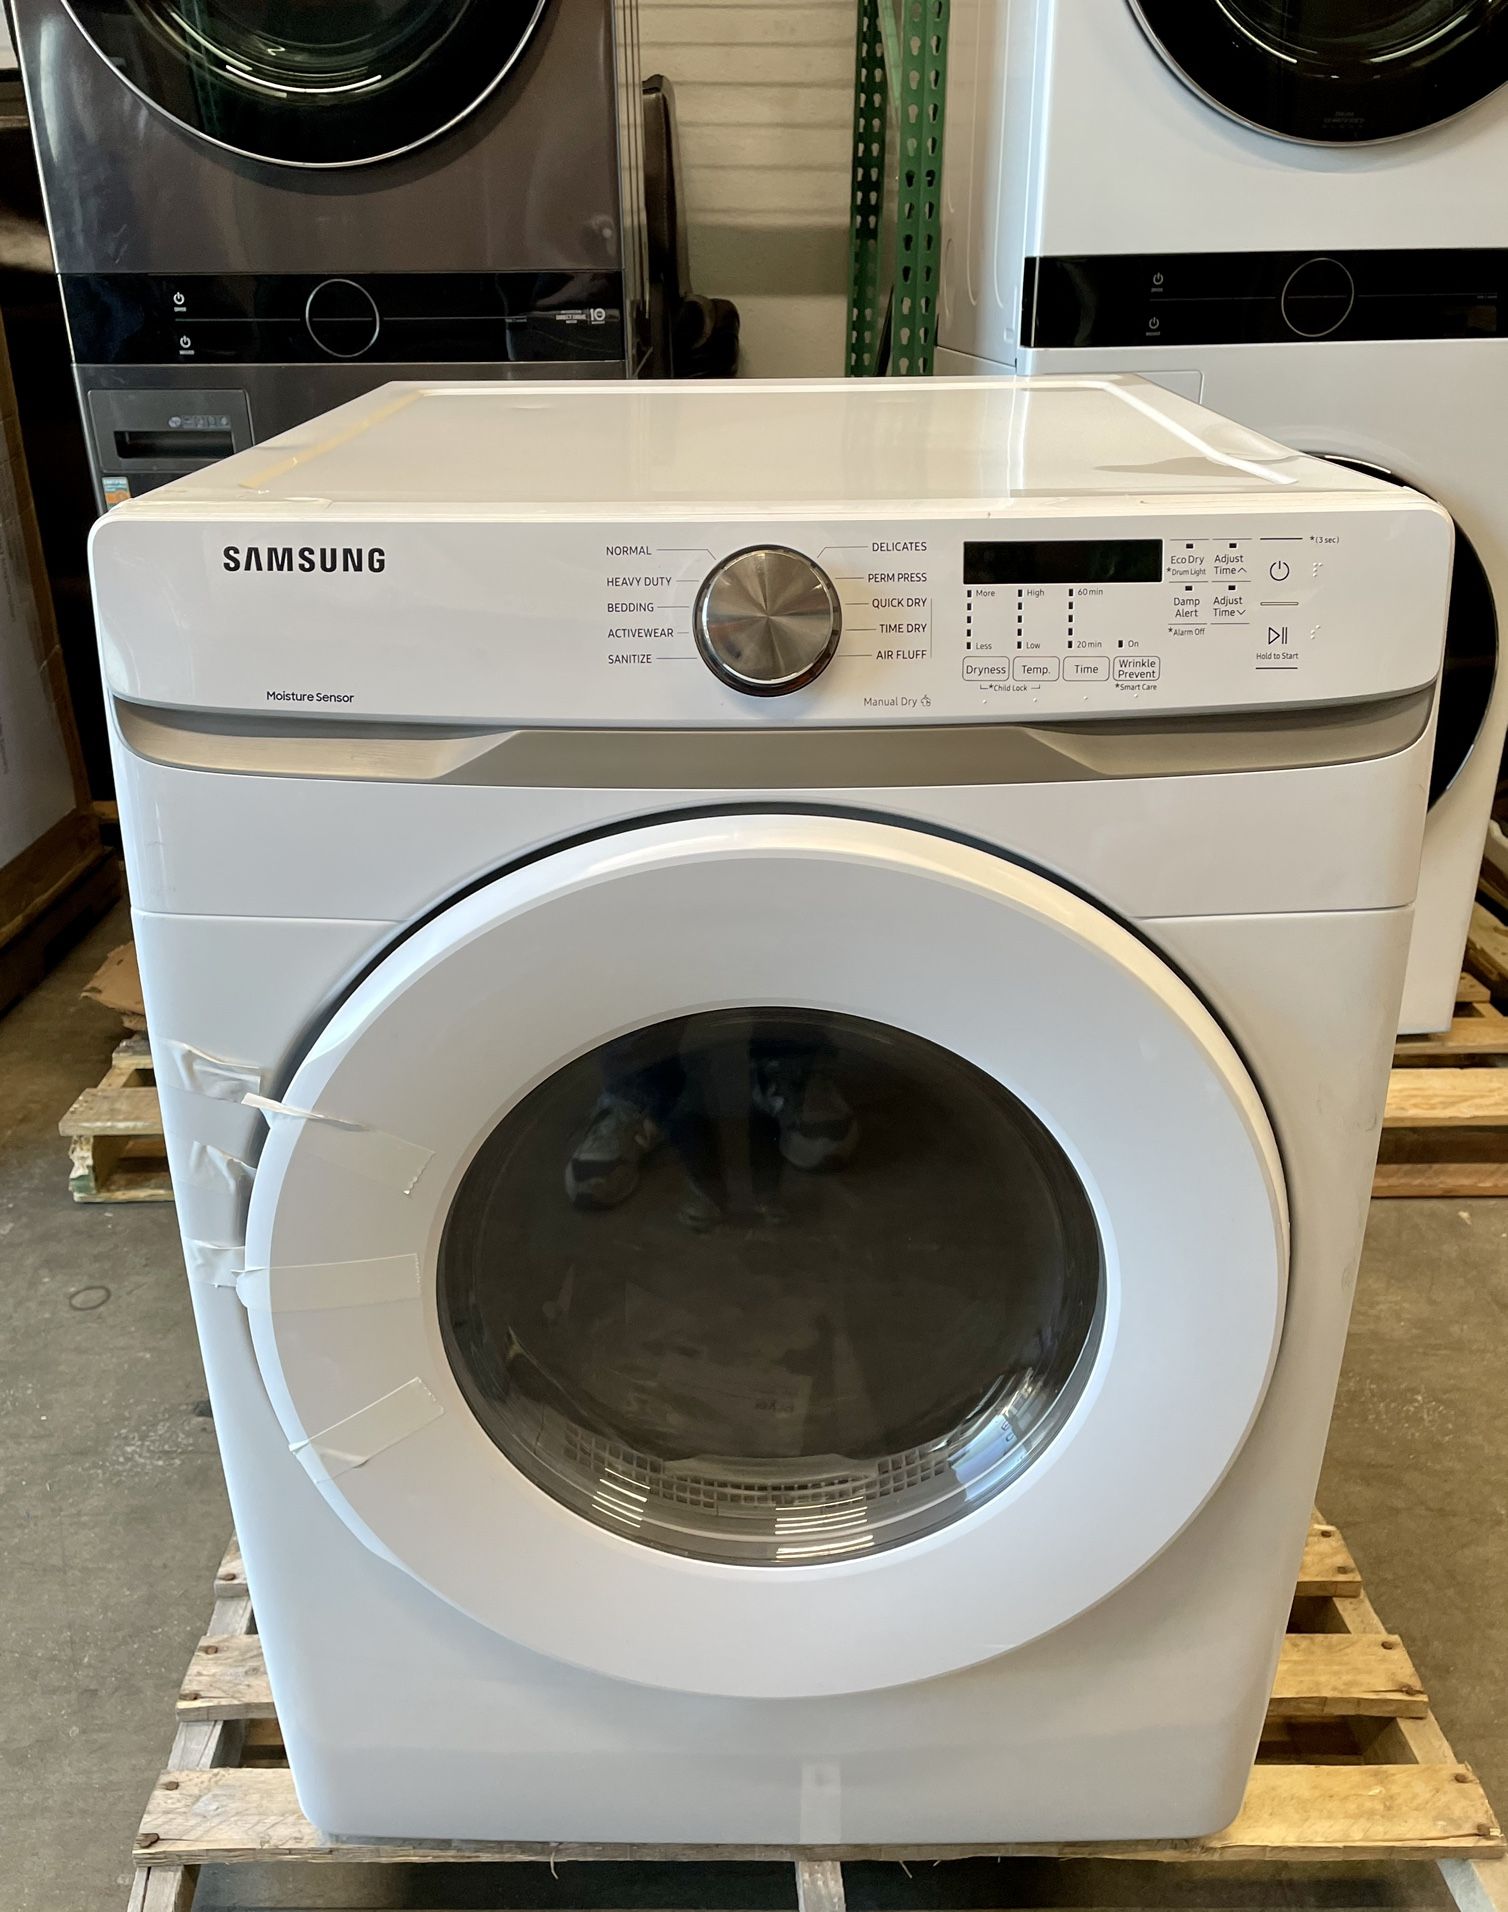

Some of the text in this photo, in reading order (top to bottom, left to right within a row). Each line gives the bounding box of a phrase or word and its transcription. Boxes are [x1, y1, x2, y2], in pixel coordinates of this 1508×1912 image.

[606, 546, 652, 556] NORMAL
[872, 542, 927, 552] DELICATES
[223, 546, 386, 573] SAMSUNG
[1171, 556, 1204, 565] Eco Dry
[1215, 555, 1243, 563] Adjust
[1214, 566, 1236, 574] Time
[607, 577, 671, 587] HEAVY DUTY
[868, 573, 927, 583] PERM PRESS
[976, 589, 995, 597] More
[1027, 588, 1044, 598] High
[872, 598, 927, 609] QUICK DRY
[1173, 598, 1200, 607] Damp
[1214, 597, 1242, 605] Adjust
[607, 603, 654, 612] BEDDING
[1213, 608, 1235, 616] Time
[1175, 609, 1198, 618] Alert
[608, 628, 674, 638] ACTIVEWEAR
[880, 624, 927, 633] TIME DRY
[976, 642, 992, 650] Less
[1027, 641, 1040, 649] Low
[1128, 640, 1139, 648] On
[608, 654, 652, 664] SANITIZE
[876, 650, 927, 660] AIR FLUFF
[1119, 660, 1156, 668] Wrinkle
[966, 665, 1006, 676] Dryness
[1022, 665, 1050, 675] Temp.
[1074, 665, 1099, 673] Time
[1118, 670, 1156, 679] Prevent
[1012, 684, 1027, 692] Lock
[266, 690, 354, 702] Moisture Sensor
[864, 697, 917, 708] Manual Dry
